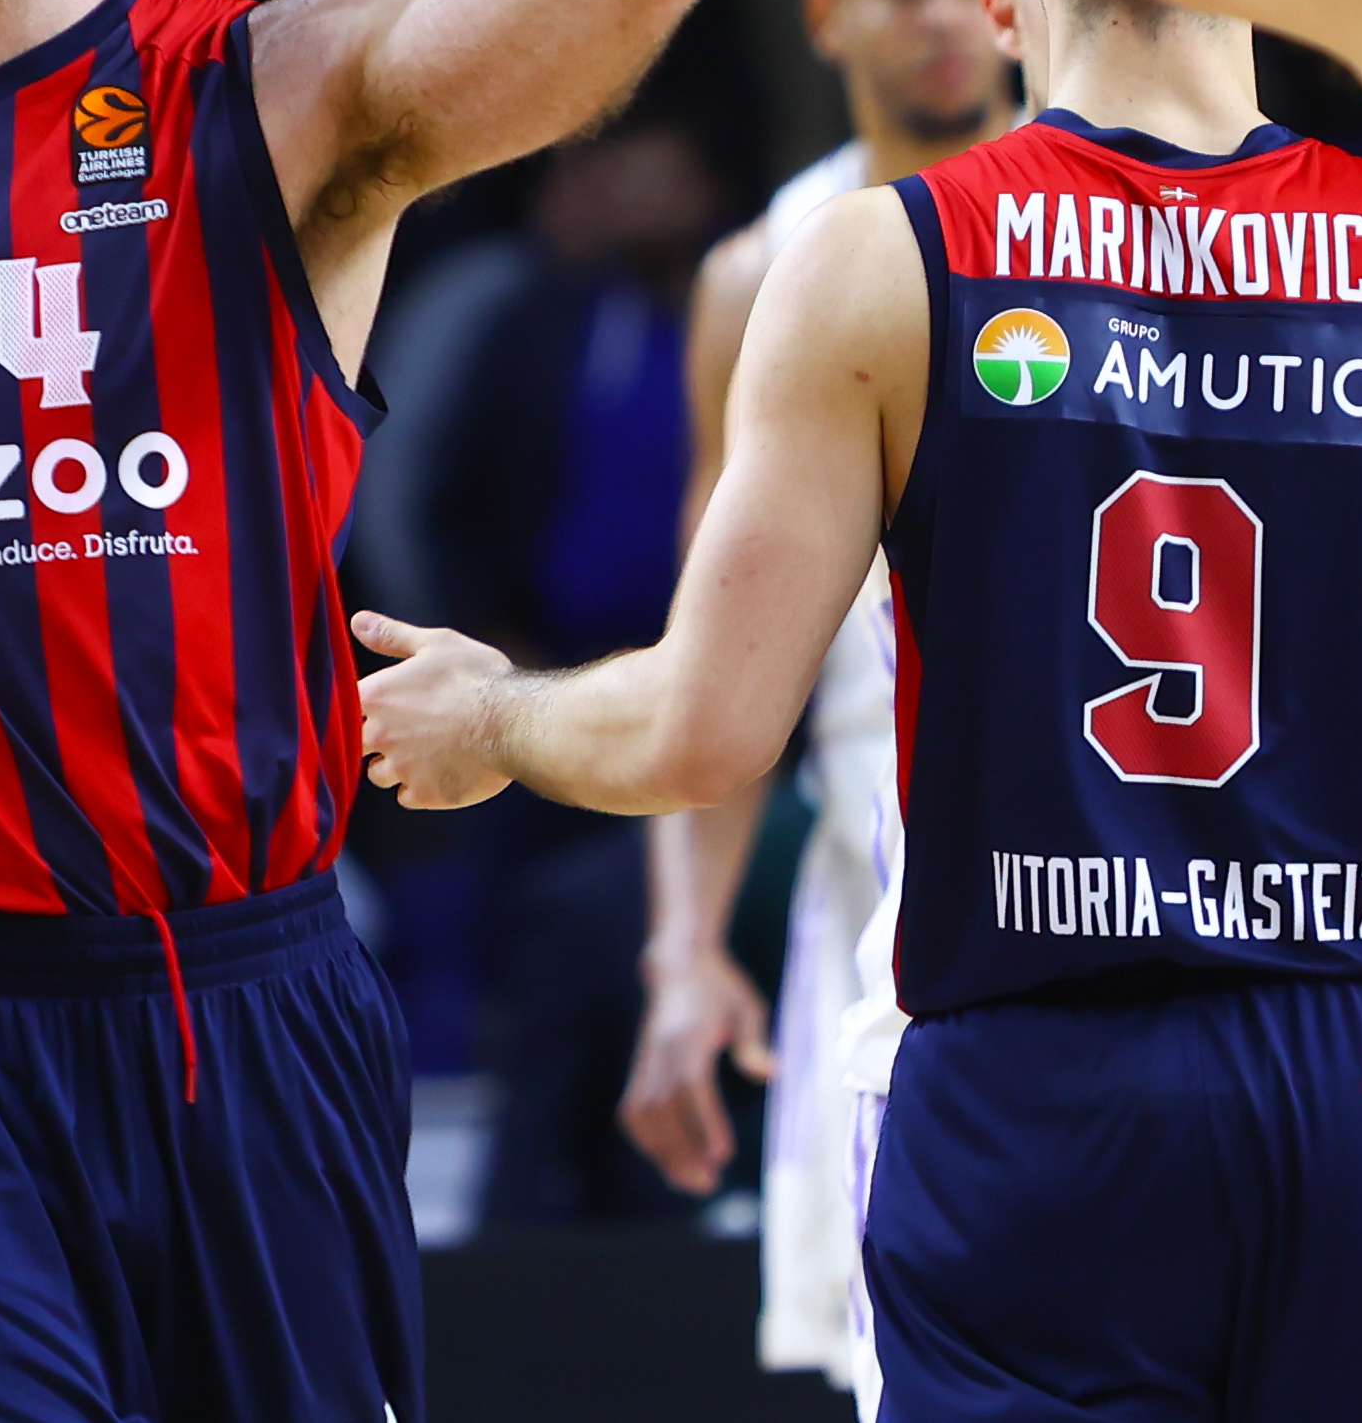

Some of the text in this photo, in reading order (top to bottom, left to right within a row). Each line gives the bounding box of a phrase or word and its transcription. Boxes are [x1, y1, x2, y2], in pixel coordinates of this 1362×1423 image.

[77, 145, 145, 163] TURKISH
[78, 156, 146, 173] AIRLINES
[62, 200, 167, 232] oneteam
[1108, 317, 1160, 342] GRUPO
[83, 528, 200, 559] Disfruta.
[1084, 469, 1264, 789] 9
